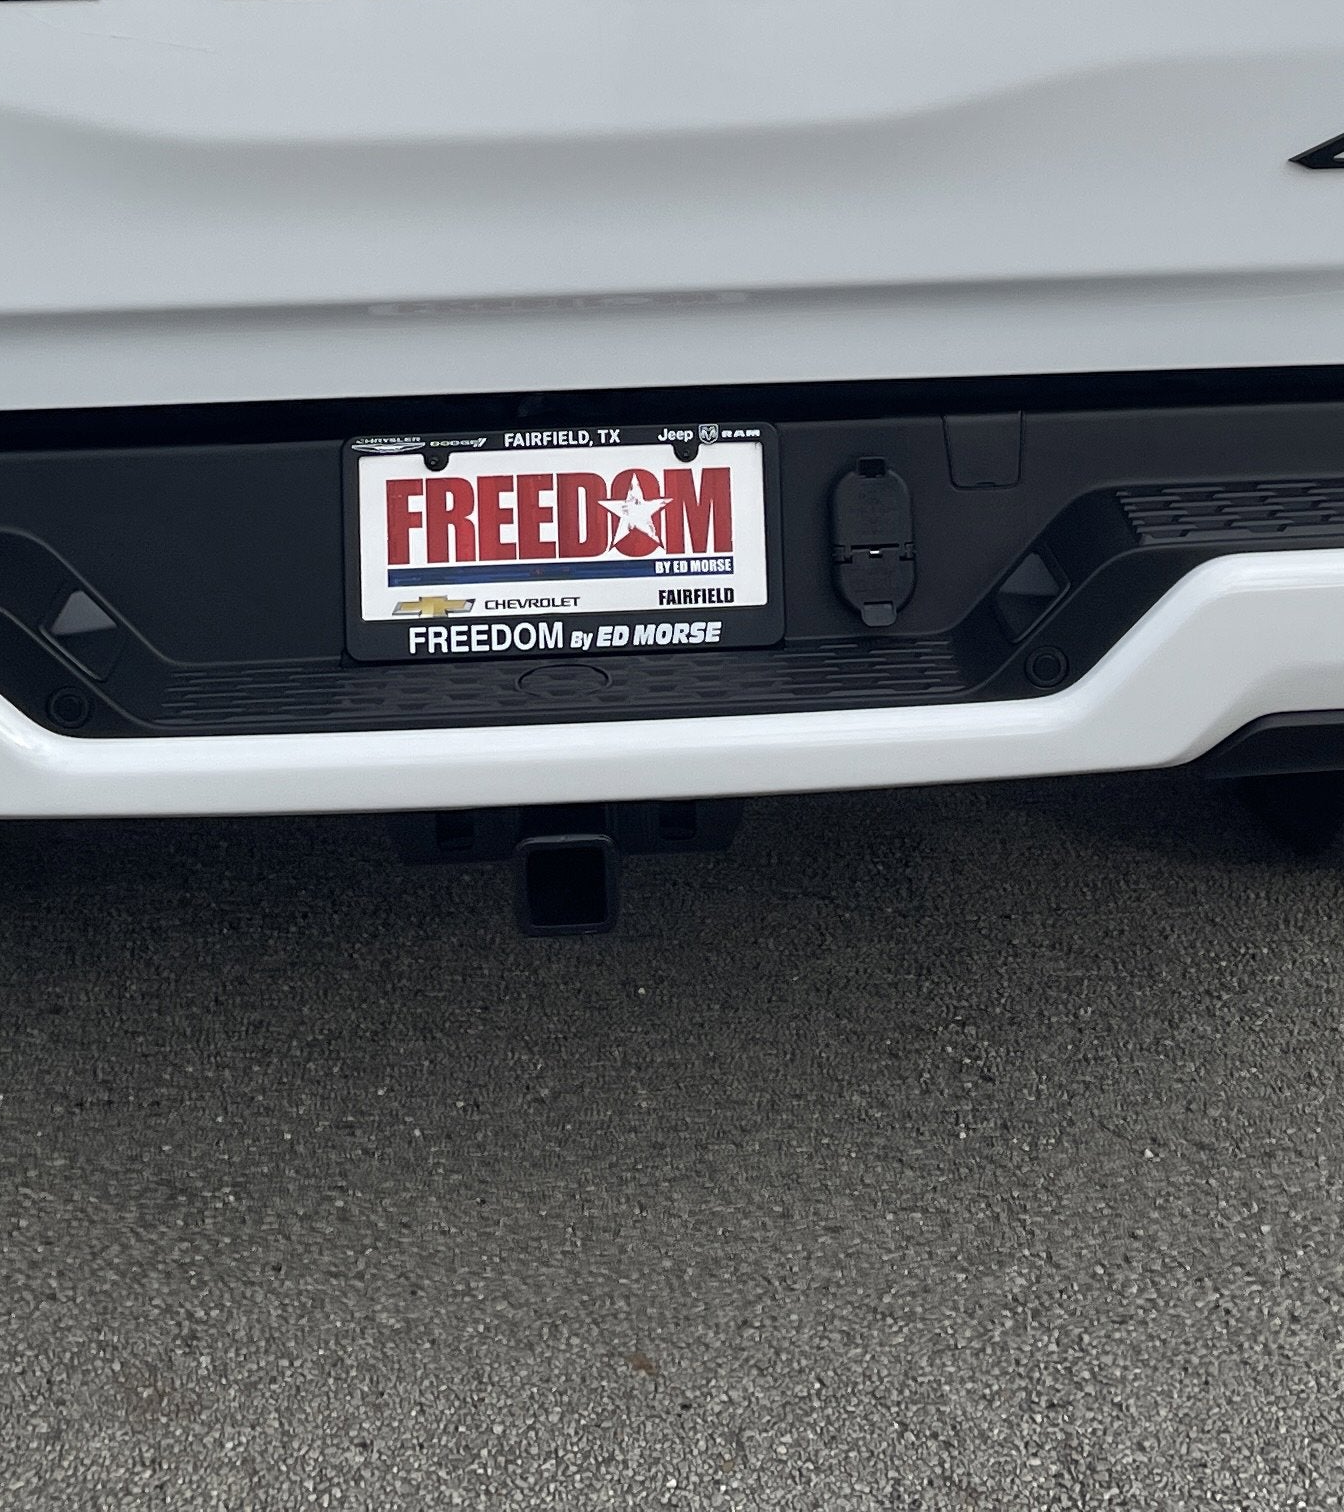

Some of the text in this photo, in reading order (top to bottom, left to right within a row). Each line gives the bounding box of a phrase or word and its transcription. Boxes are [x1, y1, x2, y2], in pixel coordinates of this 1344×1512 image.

[504, 429, 621, 447] FAIRFIELD, TX
[658, 428, 761, 443] Jeep RAM
[385, 467, 734, 566] FREEDOM
[655, 558, 732, 574] BY ED MORSE
[484, 596, 581, 610] CHEVROLET
[658, 587, 735, 606] FAIRFIELD
[408, 621, 722, 654] FREEDOM By ED MORSE
